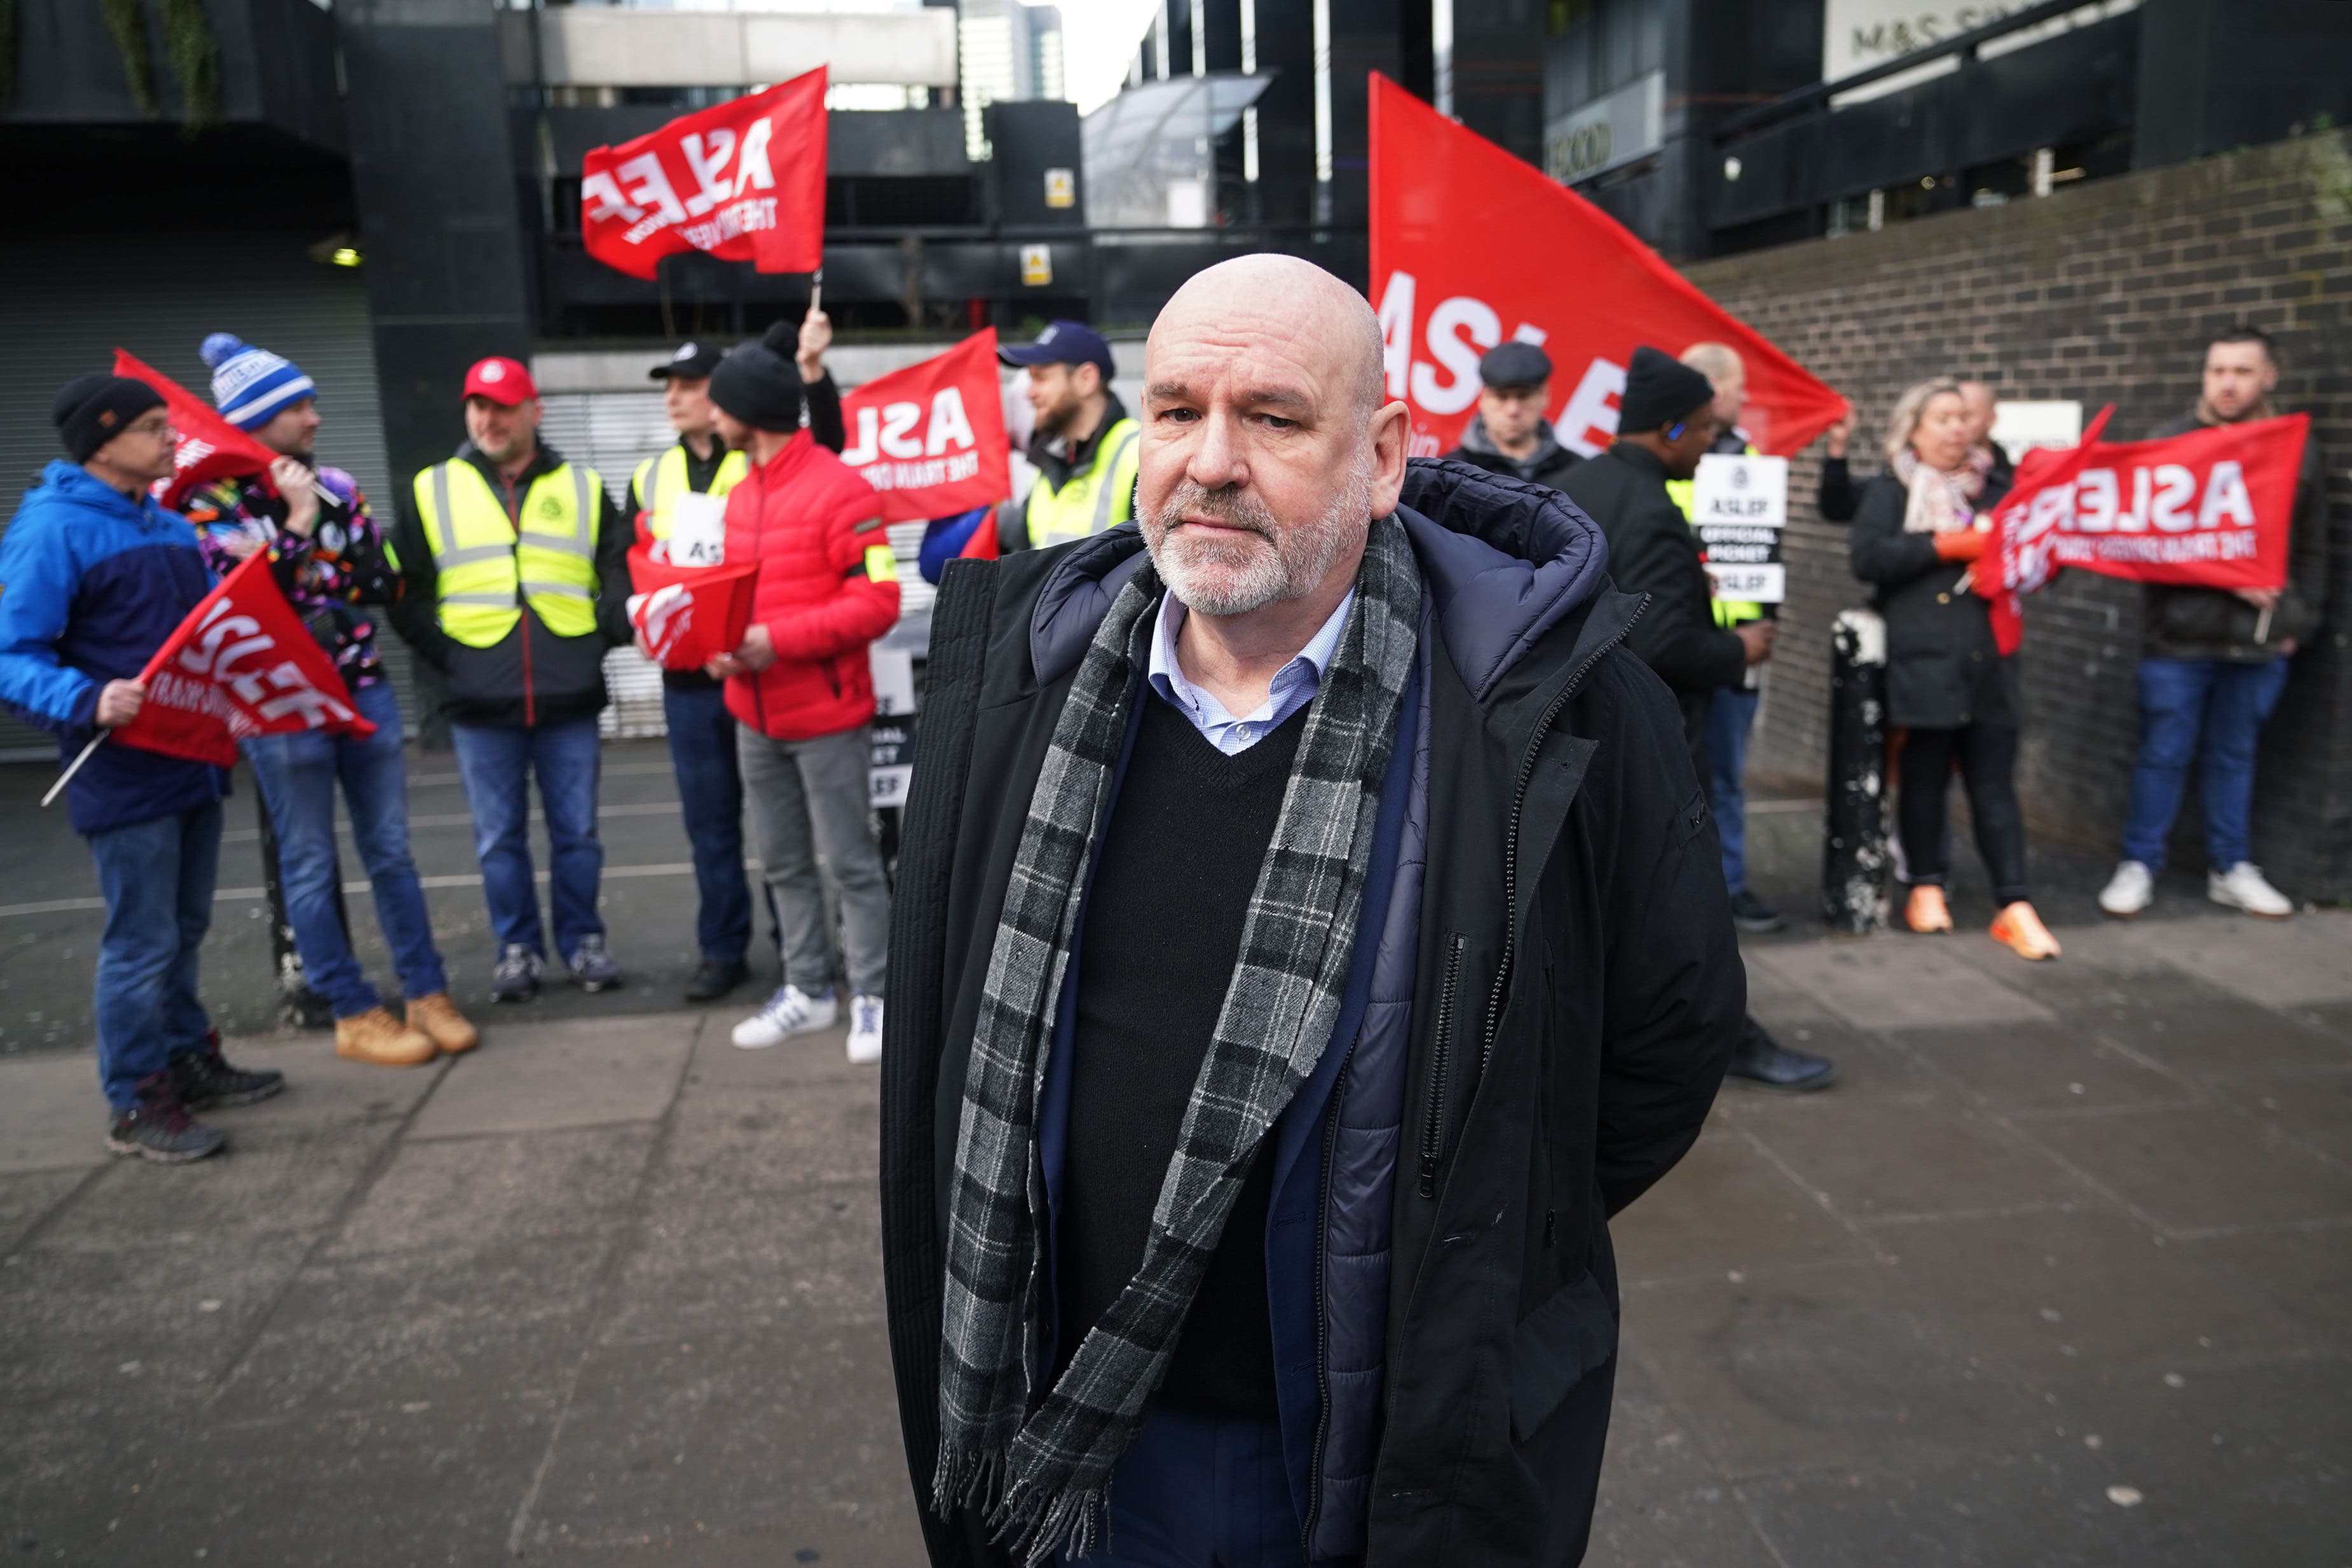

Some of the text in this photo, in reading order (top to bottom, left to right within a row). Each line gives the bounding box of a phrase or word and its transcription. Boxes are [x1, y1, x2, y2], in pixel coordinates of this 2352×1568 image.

[1851, 11, 1942, 58] M&S
[1378, 269, 1629, 460] ASE
[1710, 498, 1768, 516] ASLEF
